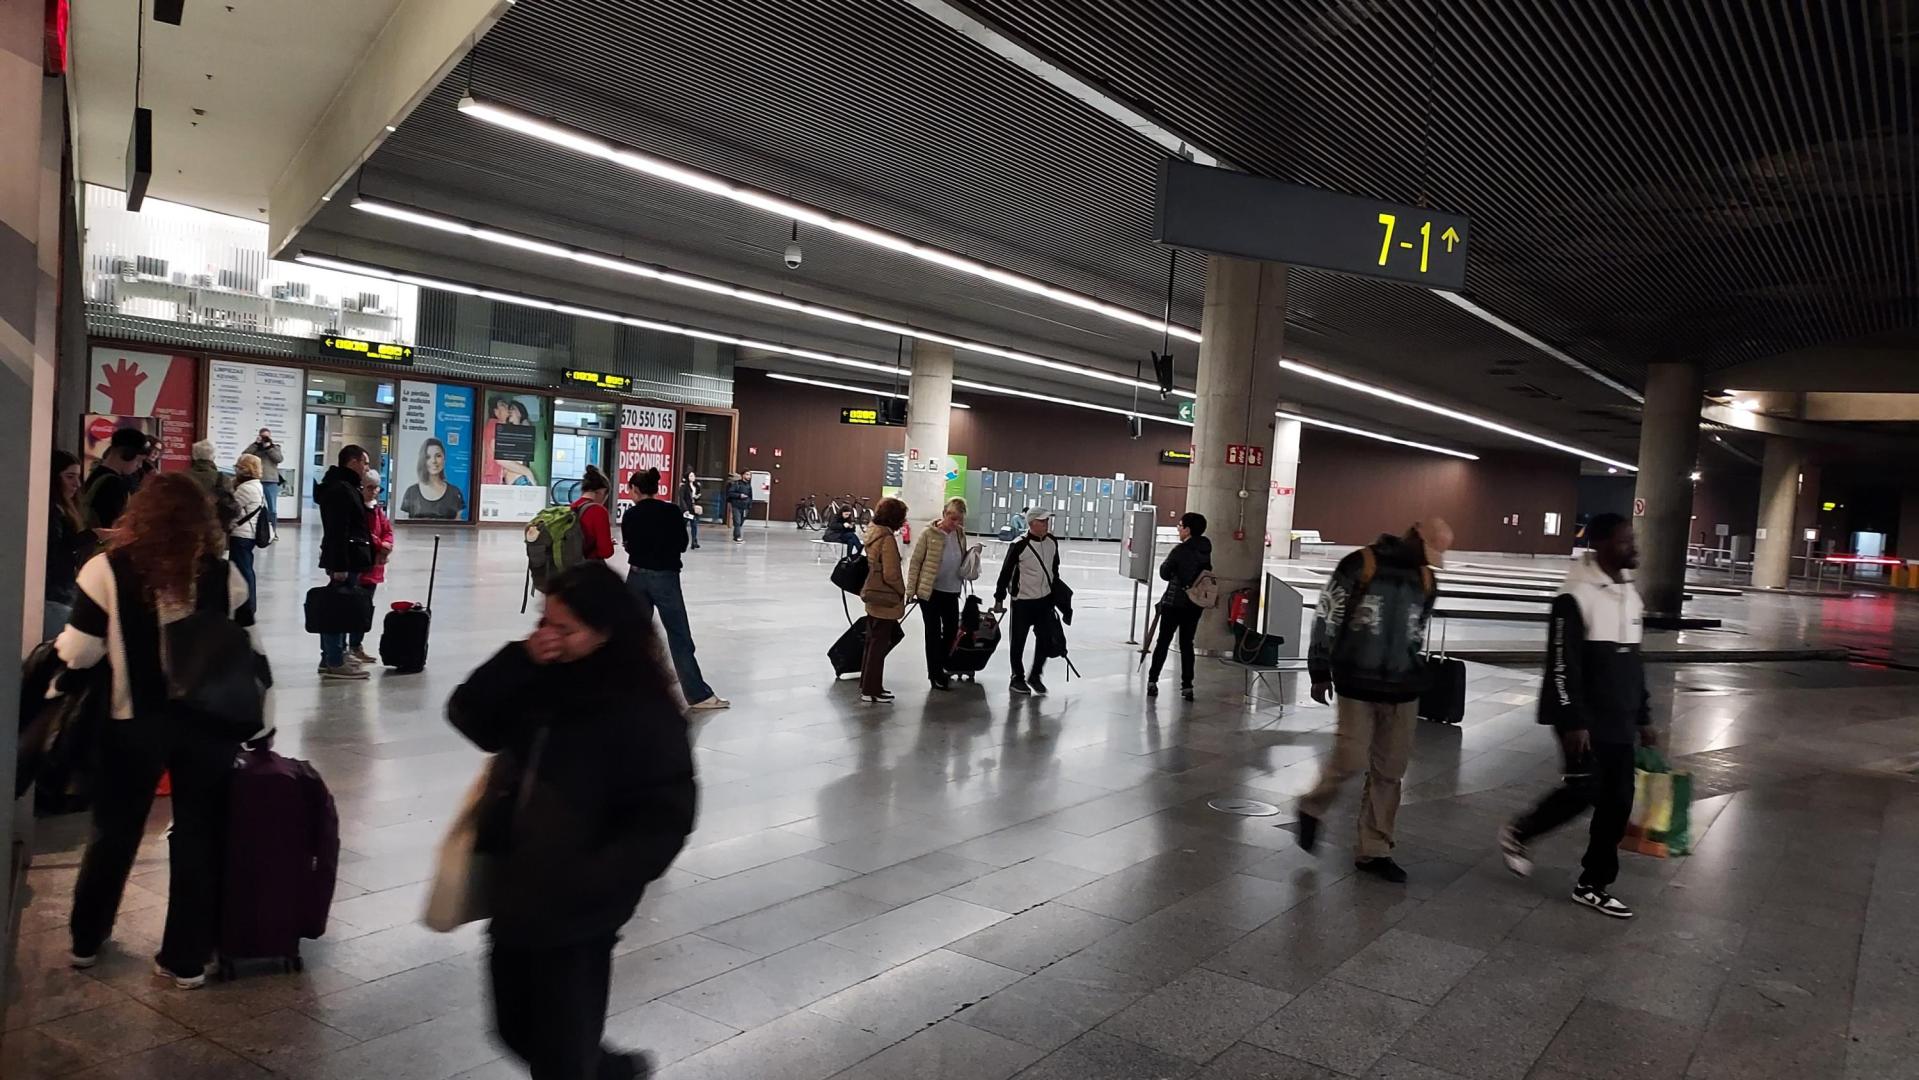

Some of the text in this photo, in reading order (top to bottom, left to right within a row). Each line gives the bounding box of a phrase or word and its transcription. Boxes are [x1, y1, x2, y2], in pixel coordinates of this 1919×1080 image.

[1379, 213, 1431, 272] 7-1
[639, 410, 655, 428] 550
[658, 413, 673, 430] 165
[627, 432, 665, 453] ESPACIO
[619, 451, 671, 472] DISPONIBLE
